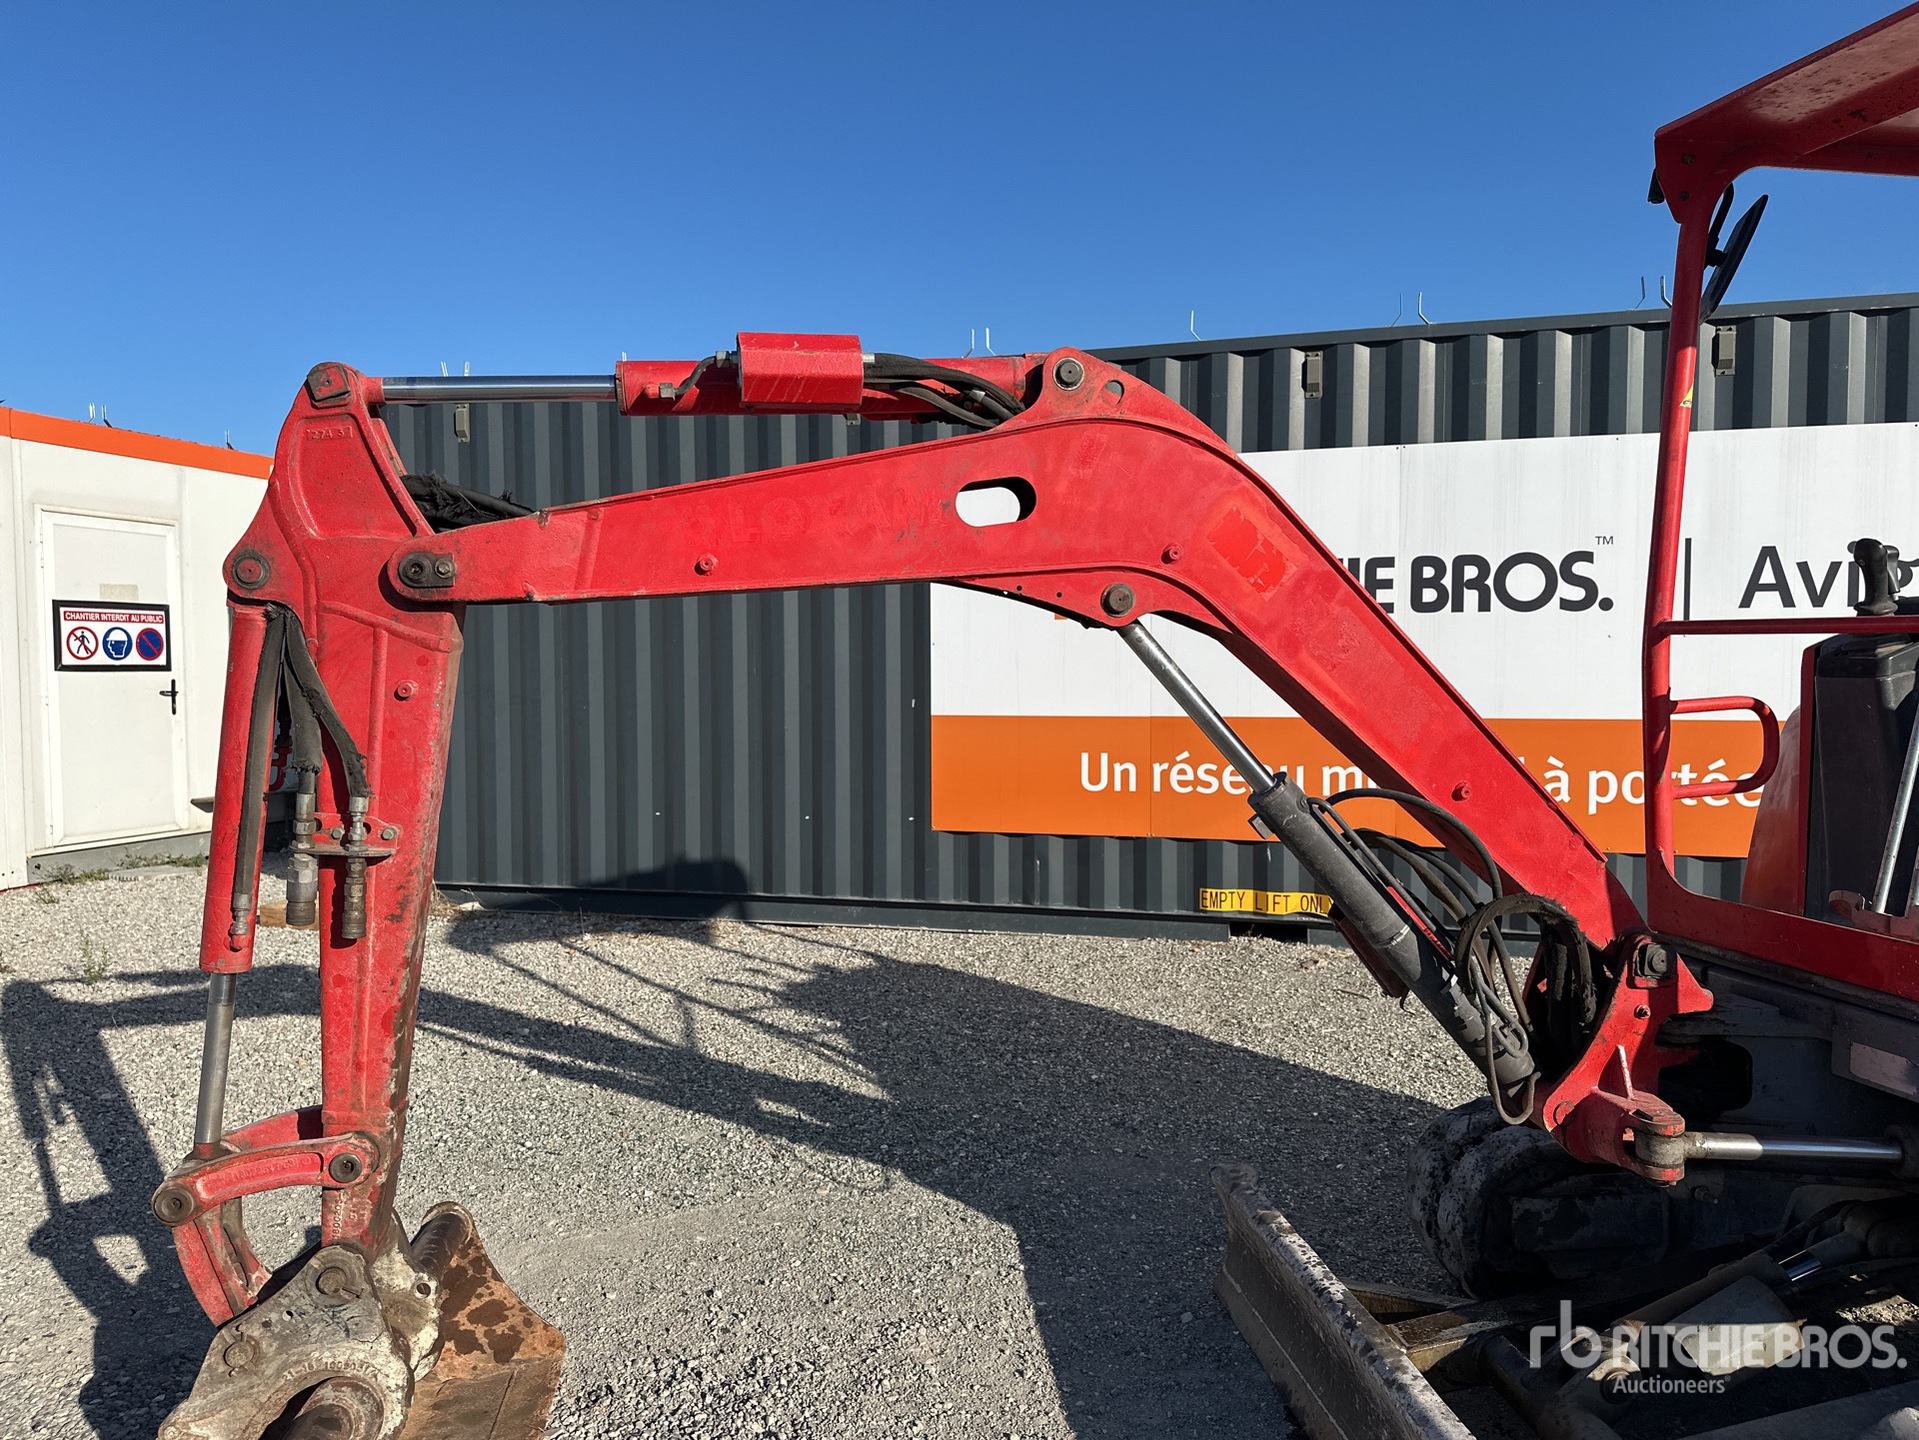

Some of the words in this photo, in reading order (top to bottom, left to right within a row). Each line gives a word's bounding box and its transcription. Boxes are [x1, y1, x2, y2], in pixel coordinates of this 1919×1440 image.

[1410, 550, 1614, 613] BROS.
[65, 612, 100, 621] CHANTIER
[101, 614, 129, 622] INTERDIT
[1080, 752, 1137, 792] Un
[1543, 755, 1571, 804] à
[1200, 890, 1246, 909] EMPTY
[1255, 893, 1290, 912] LIFT
